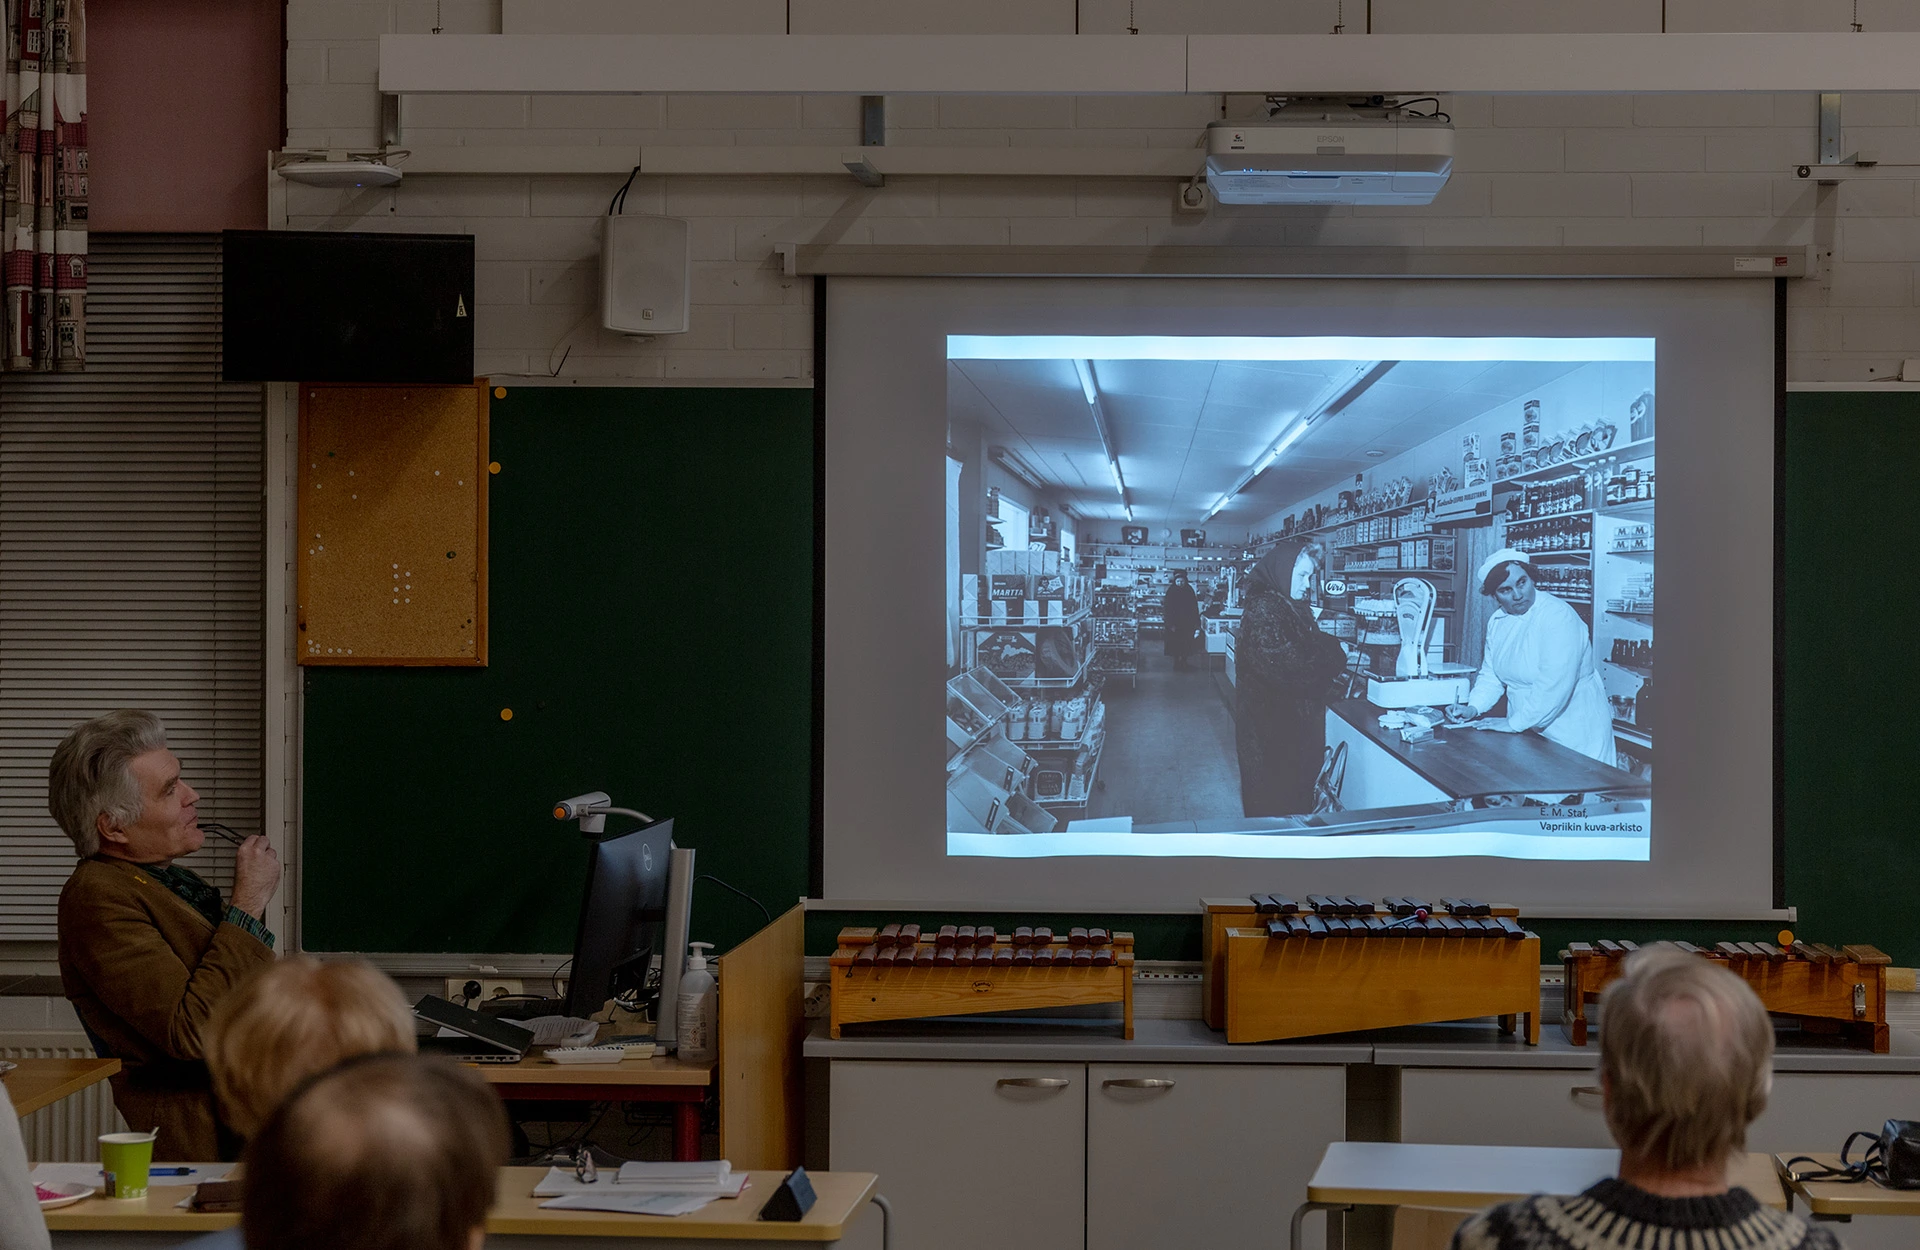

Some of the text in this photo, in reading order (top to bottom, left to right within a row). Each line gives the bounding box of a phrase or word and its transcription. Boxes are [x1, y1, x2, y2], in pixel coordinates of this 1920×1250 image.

[1317, 135, 1345, 143] EPSON
[992, 589, 1024, 597] MARTTA
[1540, 807, 1588, 819] E. M. Staf,
[1539, 821, 1643, 832] Vapriikin kuva-arkisto
